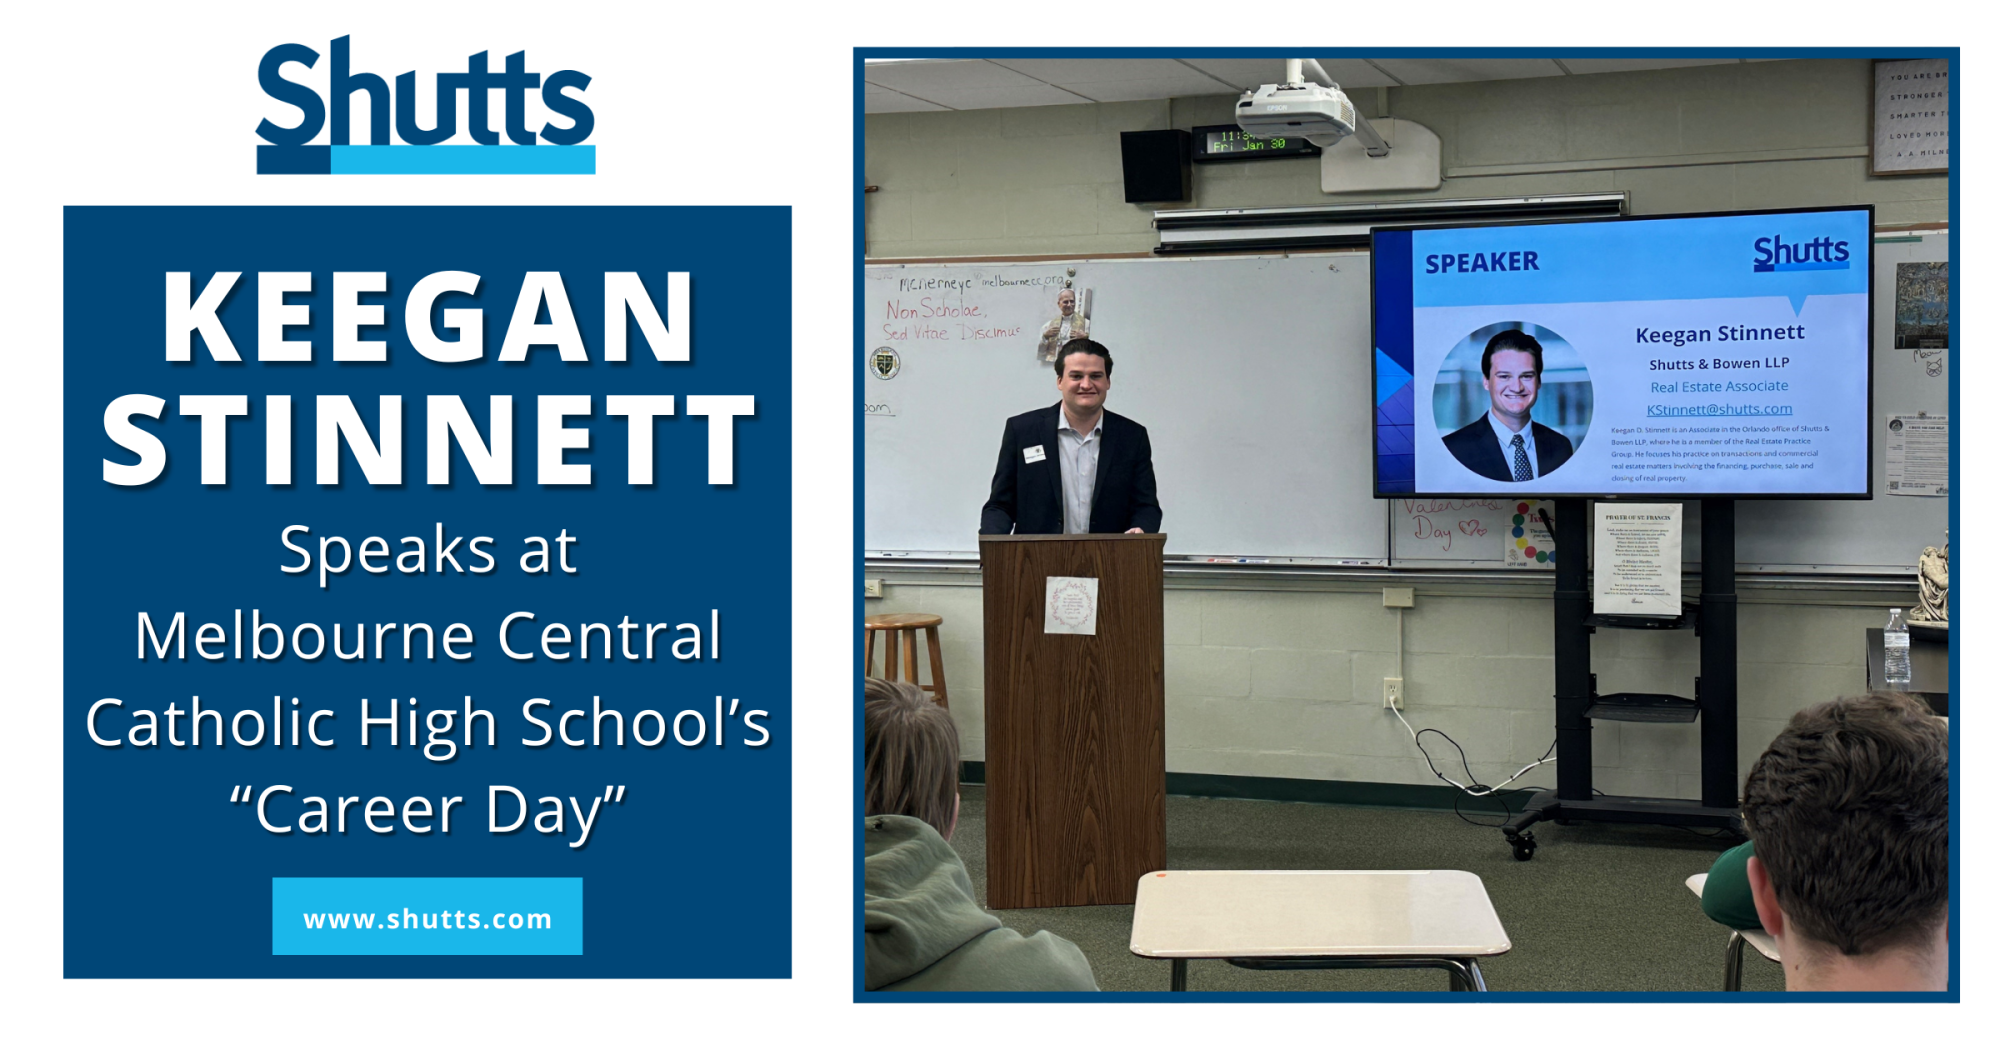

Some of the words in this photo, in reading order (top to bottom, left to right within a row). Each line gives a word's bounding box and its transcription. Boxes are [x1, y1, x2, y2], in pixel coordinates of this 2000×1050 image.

[1891, 92, 1943, 100] STRONGER
[1890, 111, 1936, 119] SMARTER
[1214, 142, 1233, 152] Fri
[1243, 140, 1264, 150] Jan
[1271, 138, 1286, 149] 30
[1753, 234, 1850, 265] Shutts
[1425, 250, 1540, 274] SPEAKER
[886, 300, 918, 320] Non
[882, 323, 908, 341] Sed
[1636, 326, 1712, 347] Keegan
[1717, 323, 1806, 342] Stinnett
[1649, 358, 1695, 371] Shutts
[1698, 358, 1709, 370] &
[1713, 357, 1761, 370] Bowen
[1765, 356, 1790, 369] LLP
[1651, 381, 1679, 393] Real
[1682, 380, 1722, 393] Estate
[1725, 379, 1789, 392] Associate
[1647, 402, 1793, 417] KStinnett@shutts.com
[1413, 515, 1452, 551] Day
